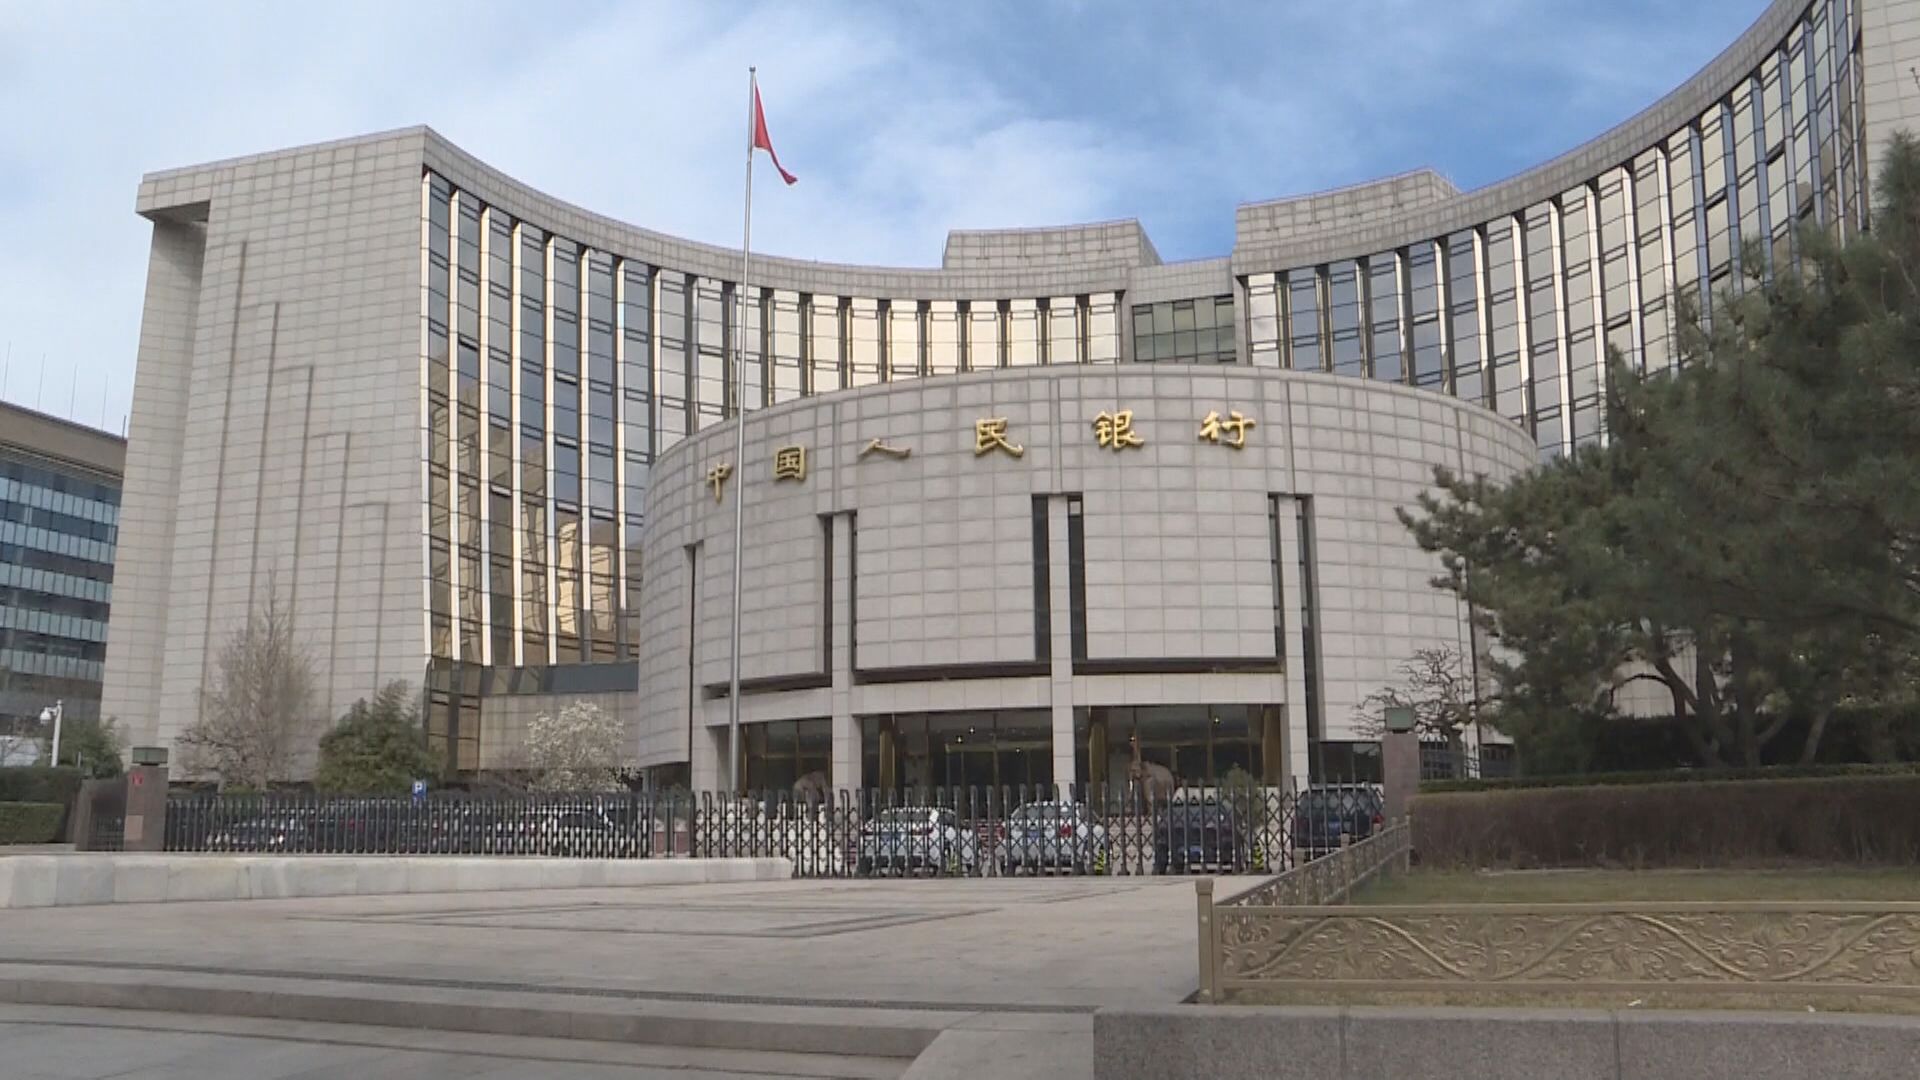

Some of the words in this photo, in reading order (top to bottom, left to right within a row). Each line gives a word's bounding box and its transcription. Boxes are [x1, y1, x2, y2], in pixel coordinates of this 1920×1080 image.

[707, 409, 1255, 503] 中国人民银行
